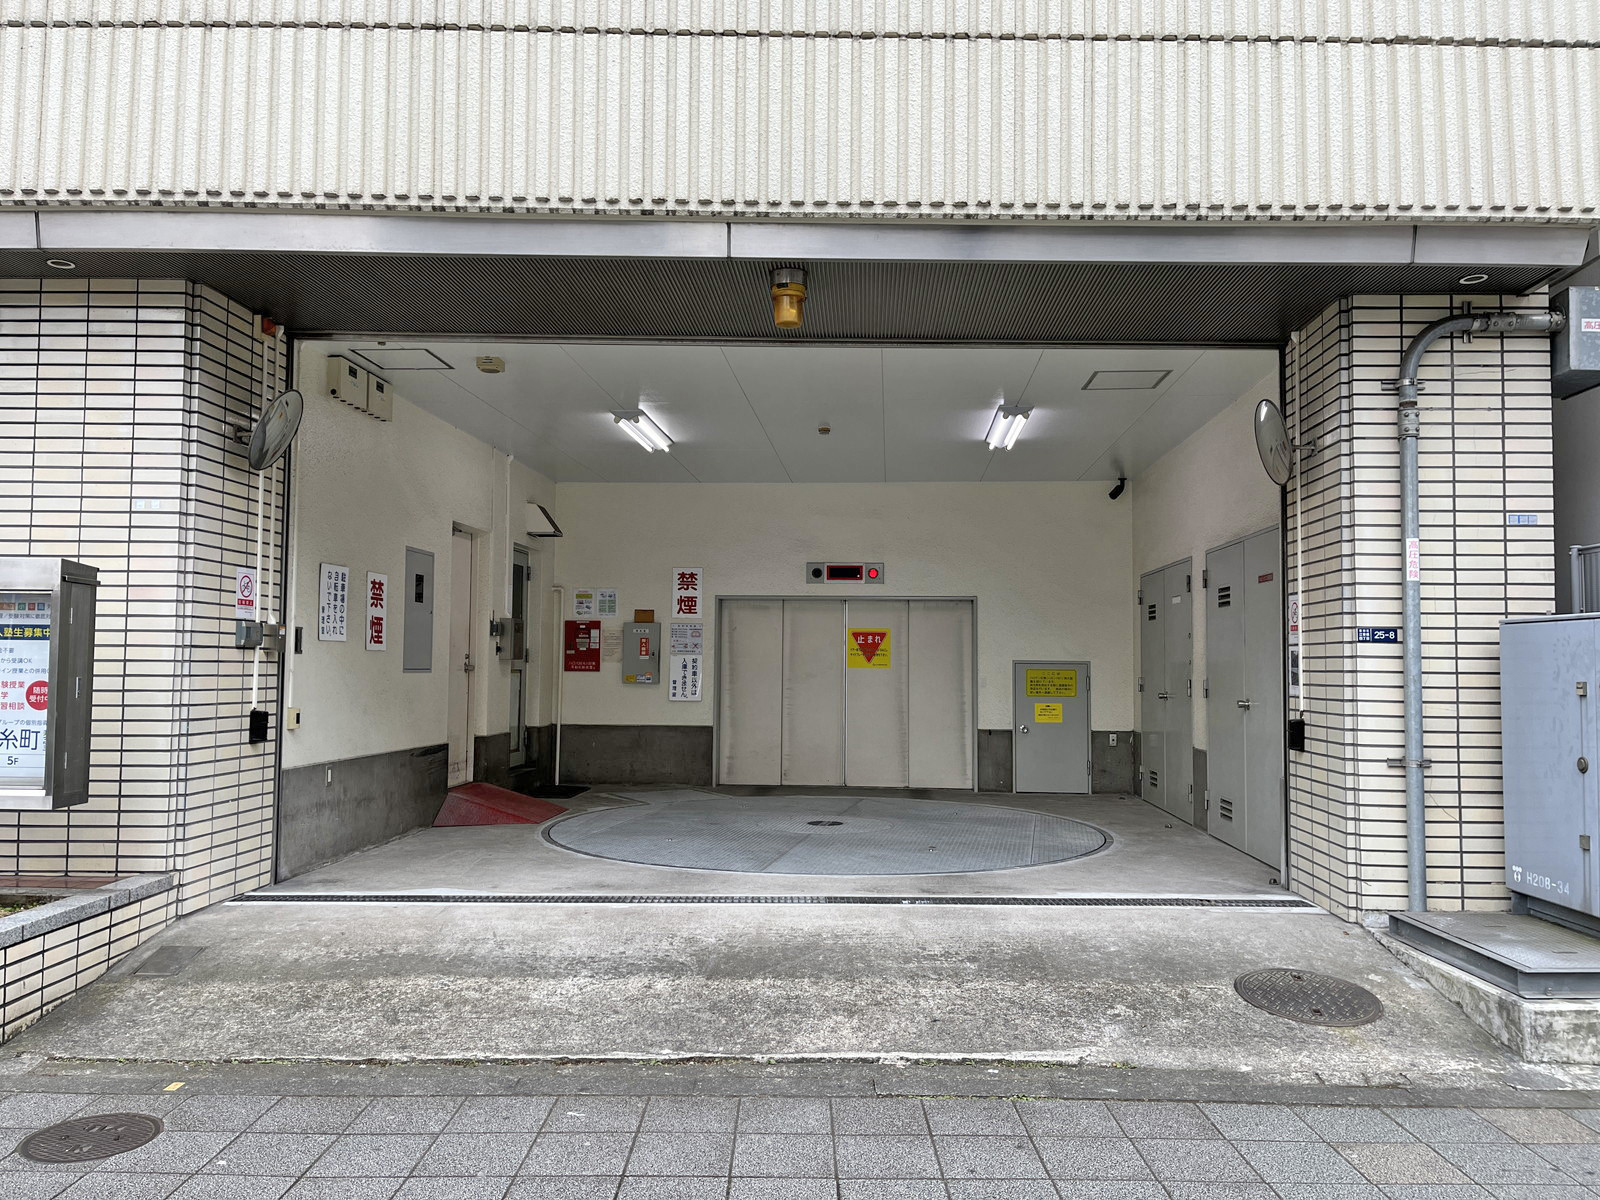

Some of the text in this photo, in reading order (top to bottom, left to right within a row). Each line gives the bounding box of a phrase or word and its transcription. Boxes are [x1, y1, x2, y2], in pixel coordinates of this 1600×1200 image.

[1408, 540, 1419, 579] 高圧危険
[677, 571, 698, 615] 禁煙
[369, 578, 384, 645] 禁煙
[857, 634, 882, 644] 止まれ
[1373, 630, 1396, 640] 25-8
[0, 728, 41, 750] 糸町
[7, 755, 19, 766] 5F
